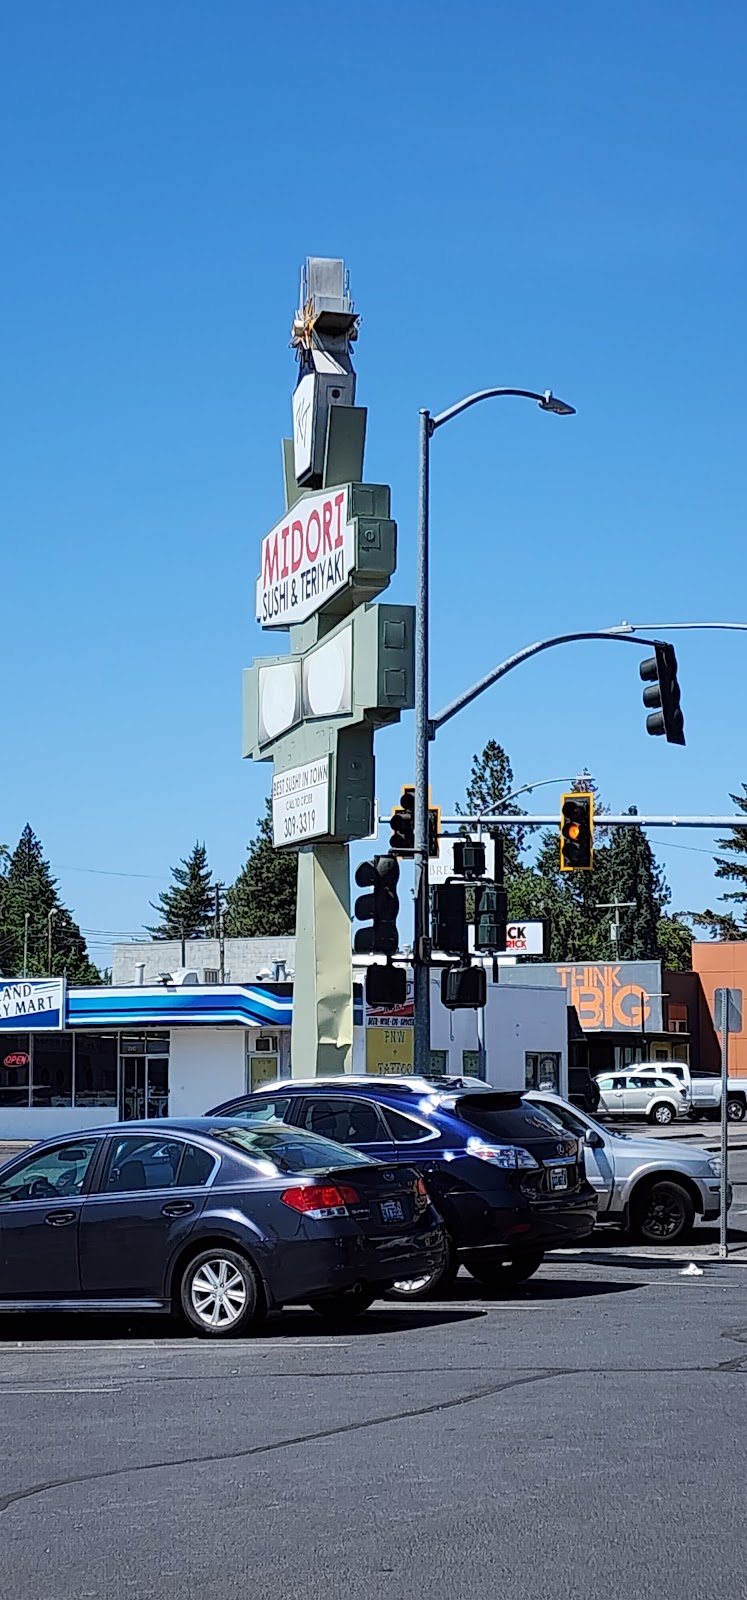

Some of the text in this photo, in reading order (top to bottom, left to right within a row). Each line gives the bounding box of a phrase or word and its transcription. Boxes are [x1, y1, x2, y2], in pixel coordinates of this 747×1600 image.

[263, 492, 345, 589] MIDORI
[262, 550, 344, 622] SUSHI & TERIYAKI
[273, 764, 328, 797] BEST SUSHI IN TOWN
[284, 809, 316, 838] 309-3319
[507, 926, 527, 939] CK
[505, 940, 527, 948] RICK
[556, 966, 622, 987] THINK
[0, 984, 32, 1001] AND
[0, 996, 53, 1017] Y MART
[571, 984, 651, 1028] BIG
[384, 1030, 406, 1043] PNW
[6, 1055, 27, 1065] OPEN
[377, 1062, 413, 1075] TATTOO
